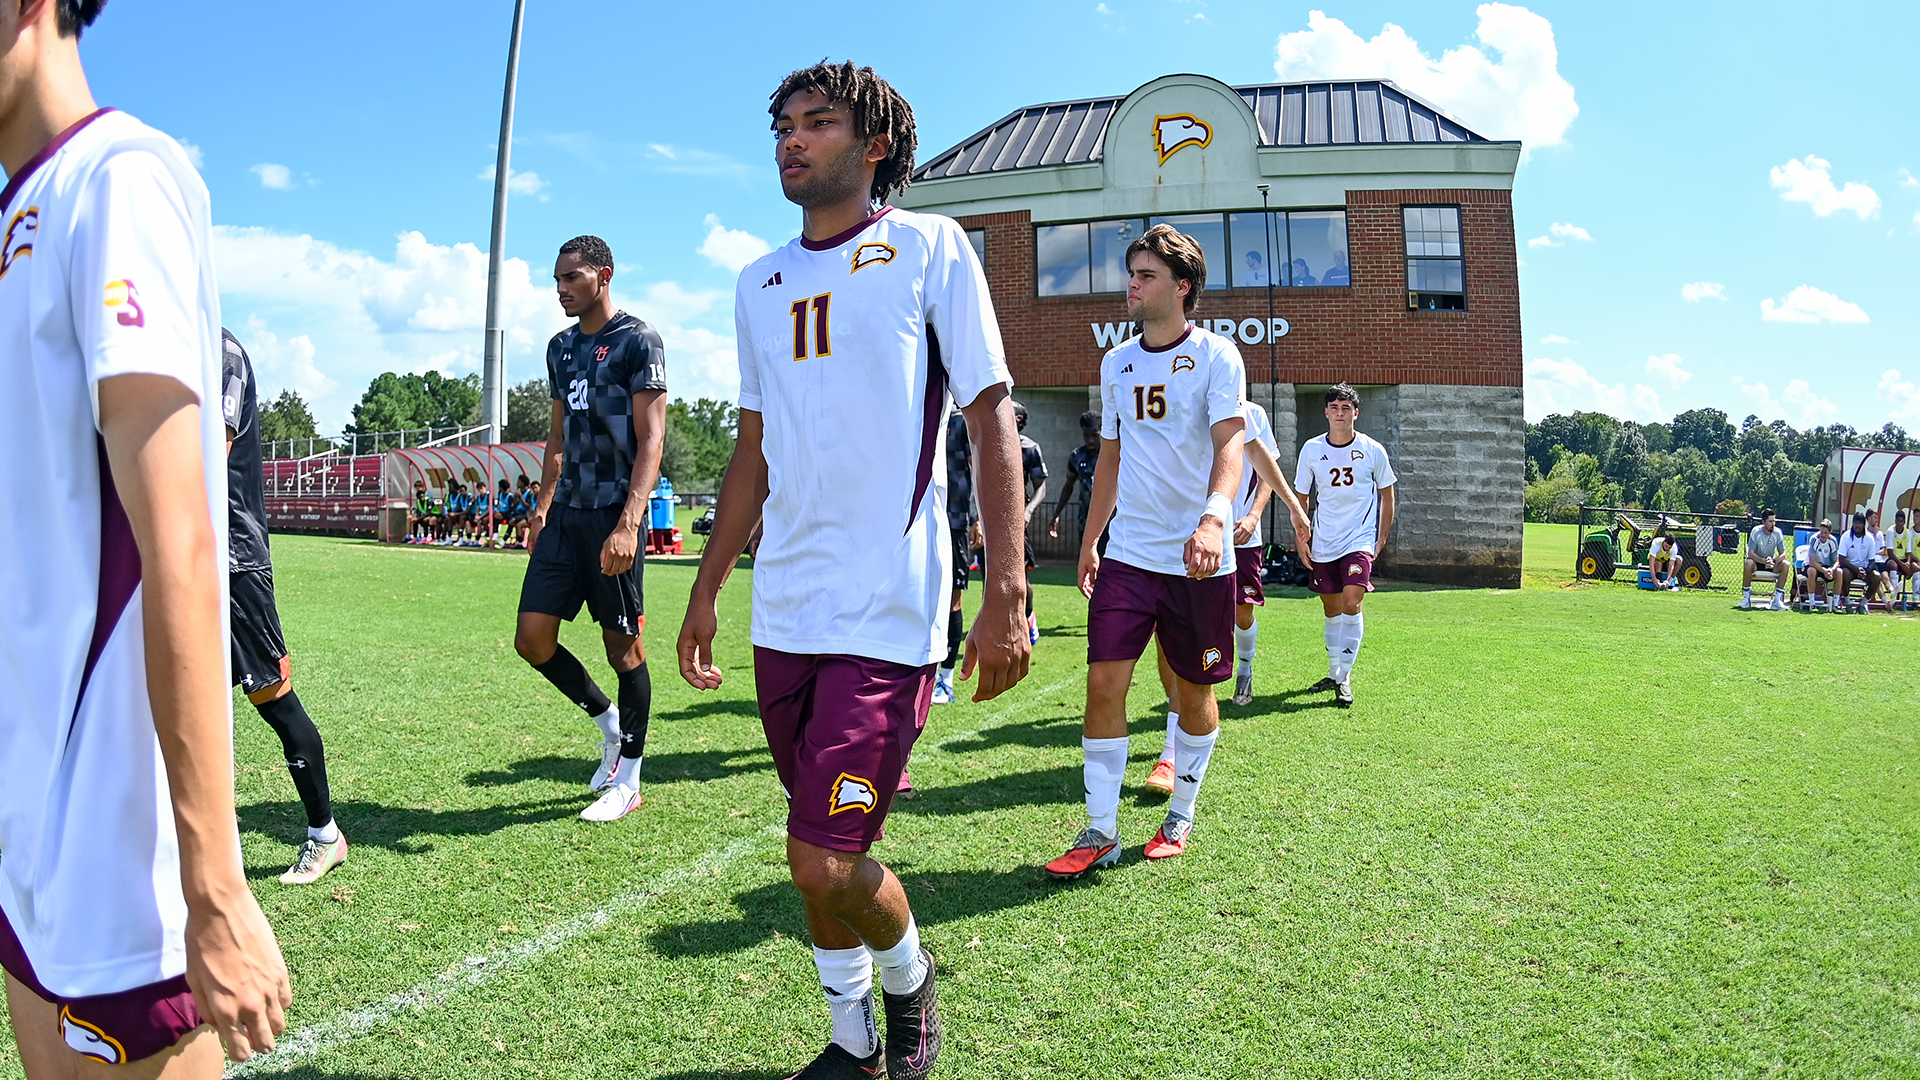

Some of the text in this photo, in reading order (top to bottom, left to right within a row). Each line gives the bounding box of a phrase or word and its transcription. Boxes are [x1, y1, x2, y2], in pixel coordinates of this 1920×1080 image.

[790, 291, 832, 362] 11
[1090, 317, 1290, 348] WROP
[649, 363, 665, 381] 19
[567, 378, 589, 410] 20
[1133, 384, 1168, 421] 15
[1329, 466, 1354, 487] 23
